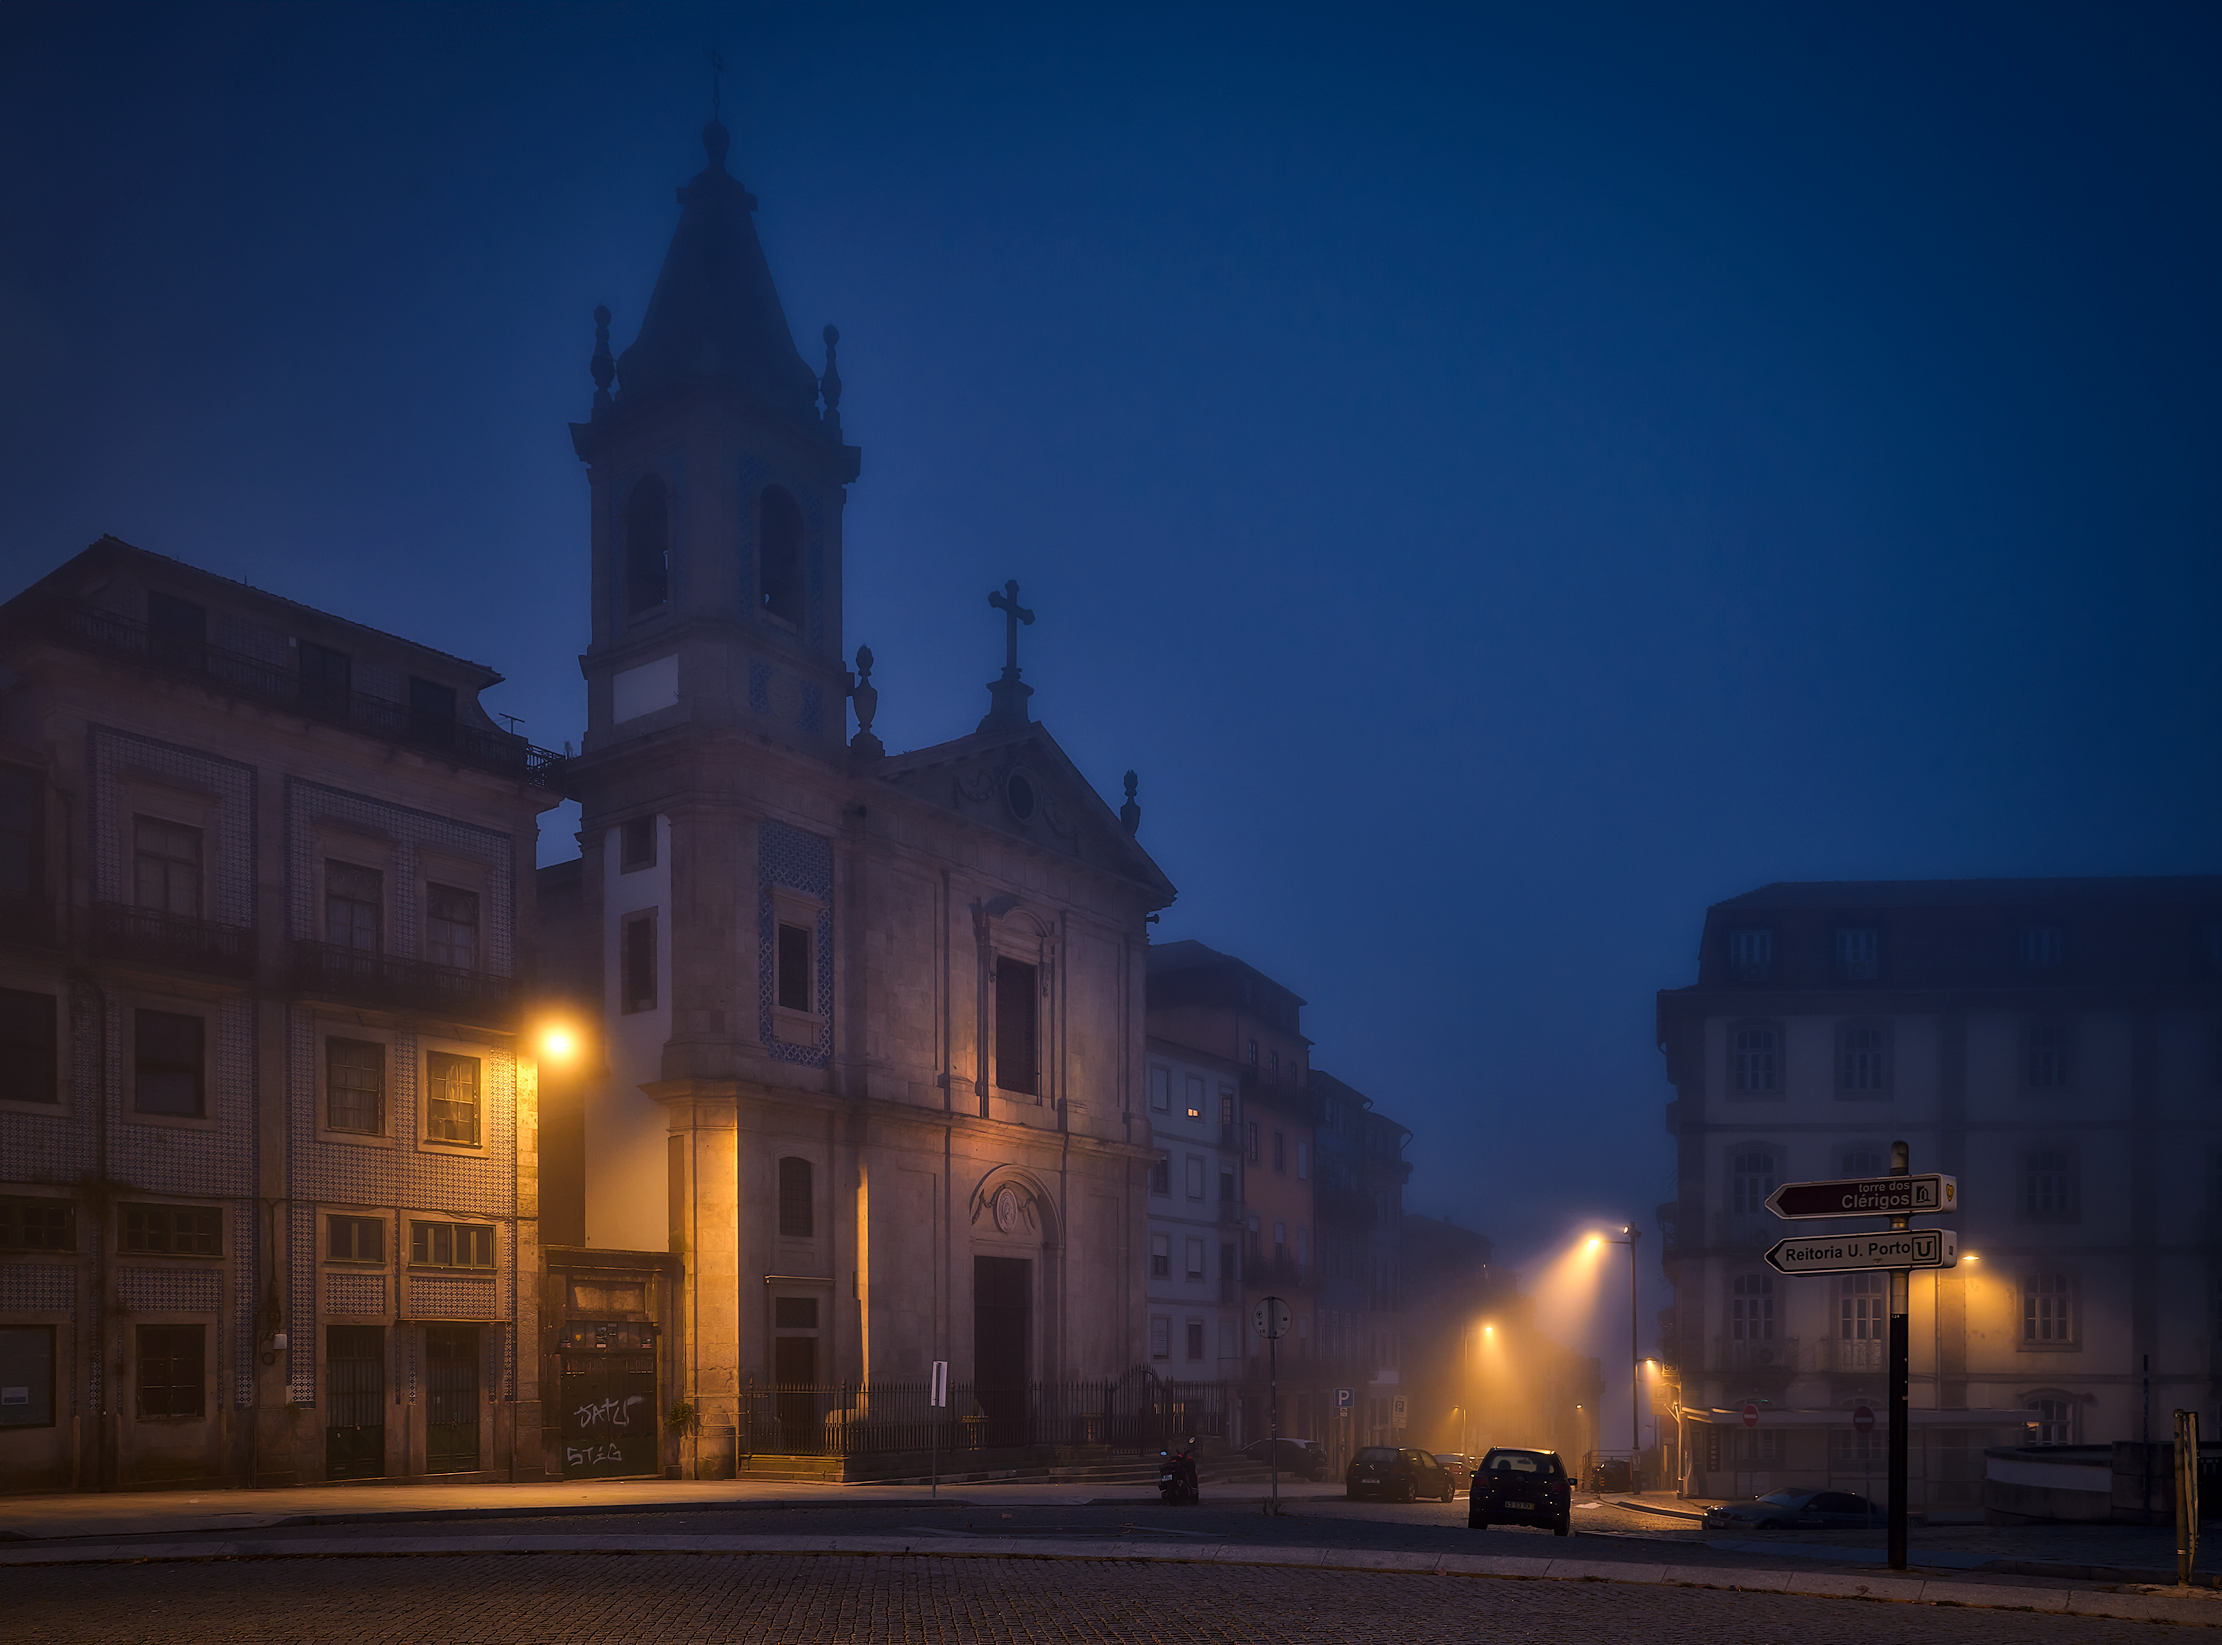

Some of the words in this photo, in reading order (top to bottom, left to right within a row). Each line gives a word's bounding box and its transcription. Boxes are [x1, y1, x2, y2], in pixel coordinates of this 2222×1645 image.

[1858, 1183, 1886, 1193] torre
[1889, 1181, 1911, 1191] dos
[1841, 1193, 1911, 1210] Clérigos
[1786, 1246, 1843, 1262] Reitoria
[1848, 1244, 1863, 1258] U.
[1868, 1242, 1911, 1256] Porto
[1915, 1241, 1933, 1257] U
[1339, 1390, 1350, 1405] P
